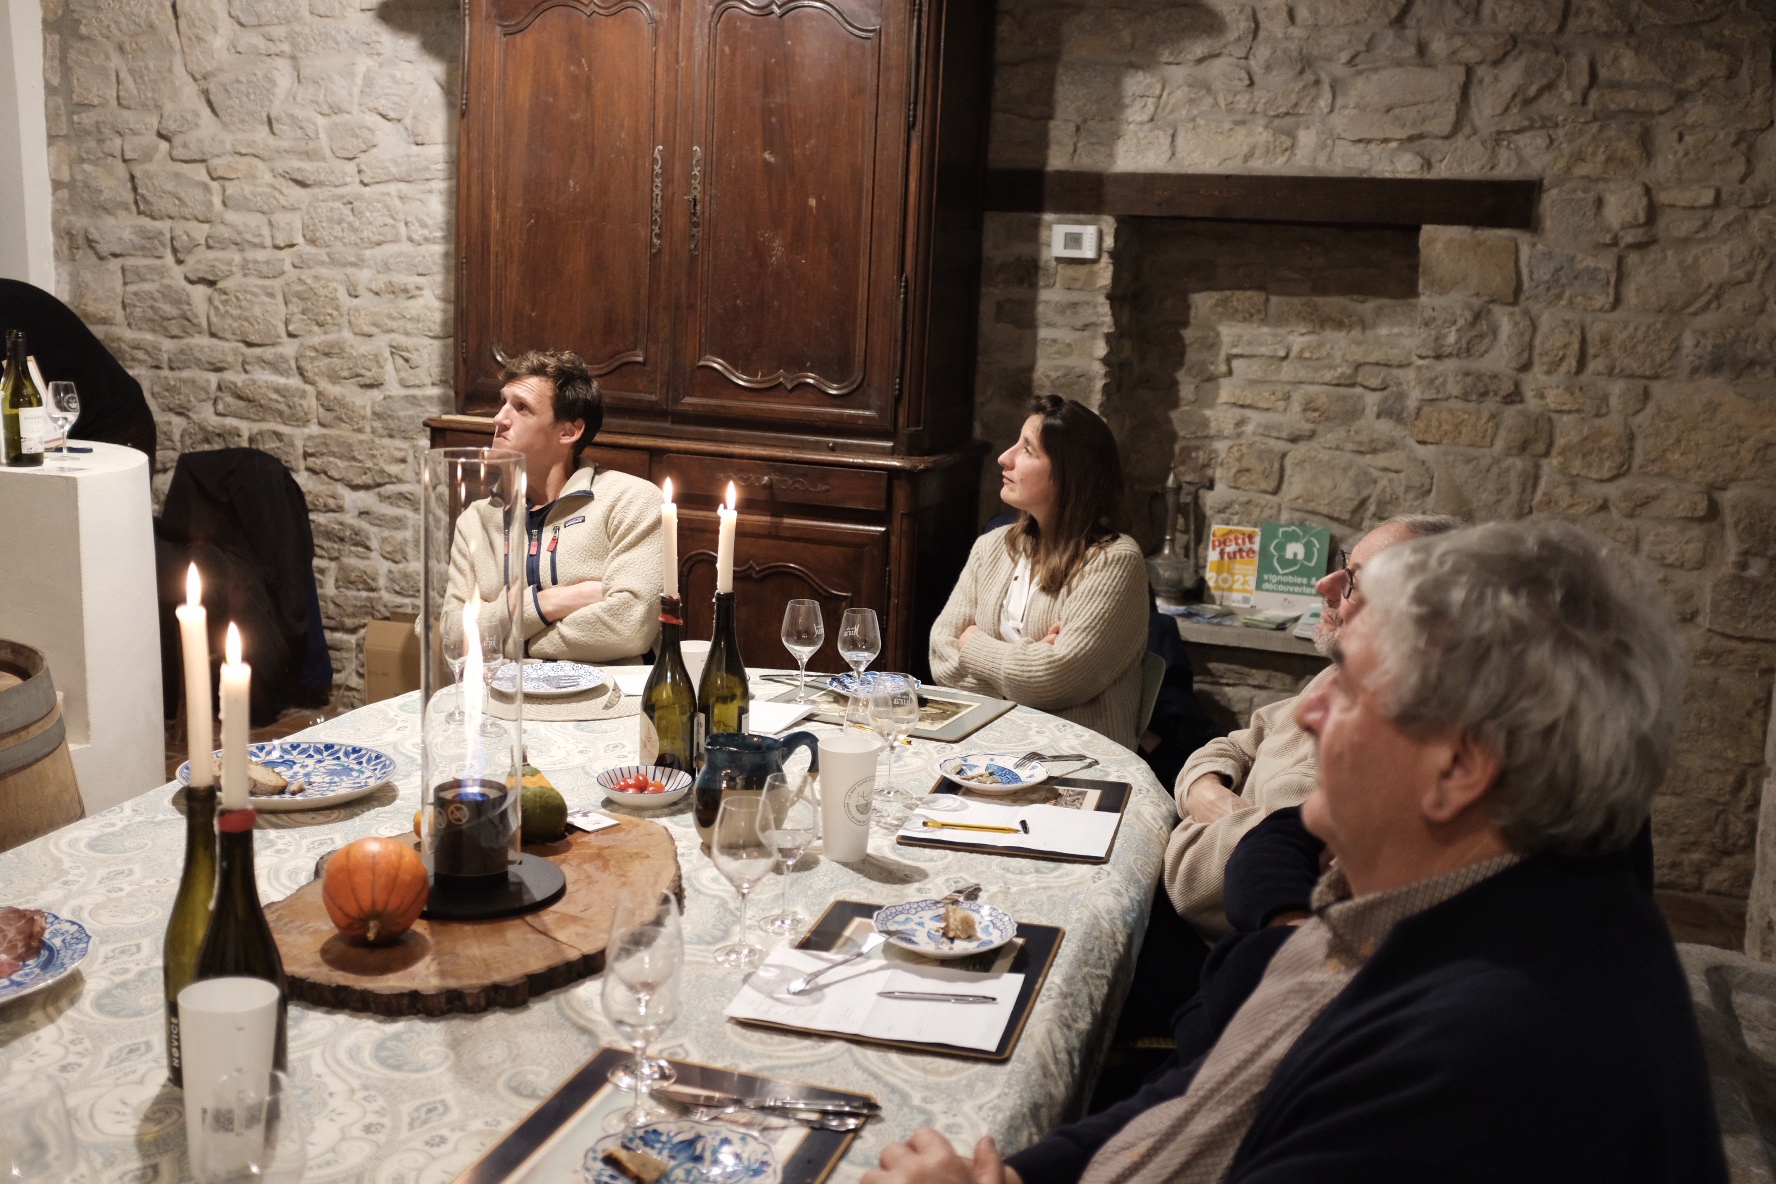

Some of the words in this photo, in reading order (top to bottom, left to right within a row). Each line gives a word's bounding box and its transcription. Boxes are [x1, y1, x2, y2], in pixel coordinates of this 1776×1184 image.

[1212, 533, 1255, 551] petit
[1207, 572, 1256, 590] 2023
[1264, 573, 1307, 584] vignobles
[1262, 583, 1316, 594] découvertes
